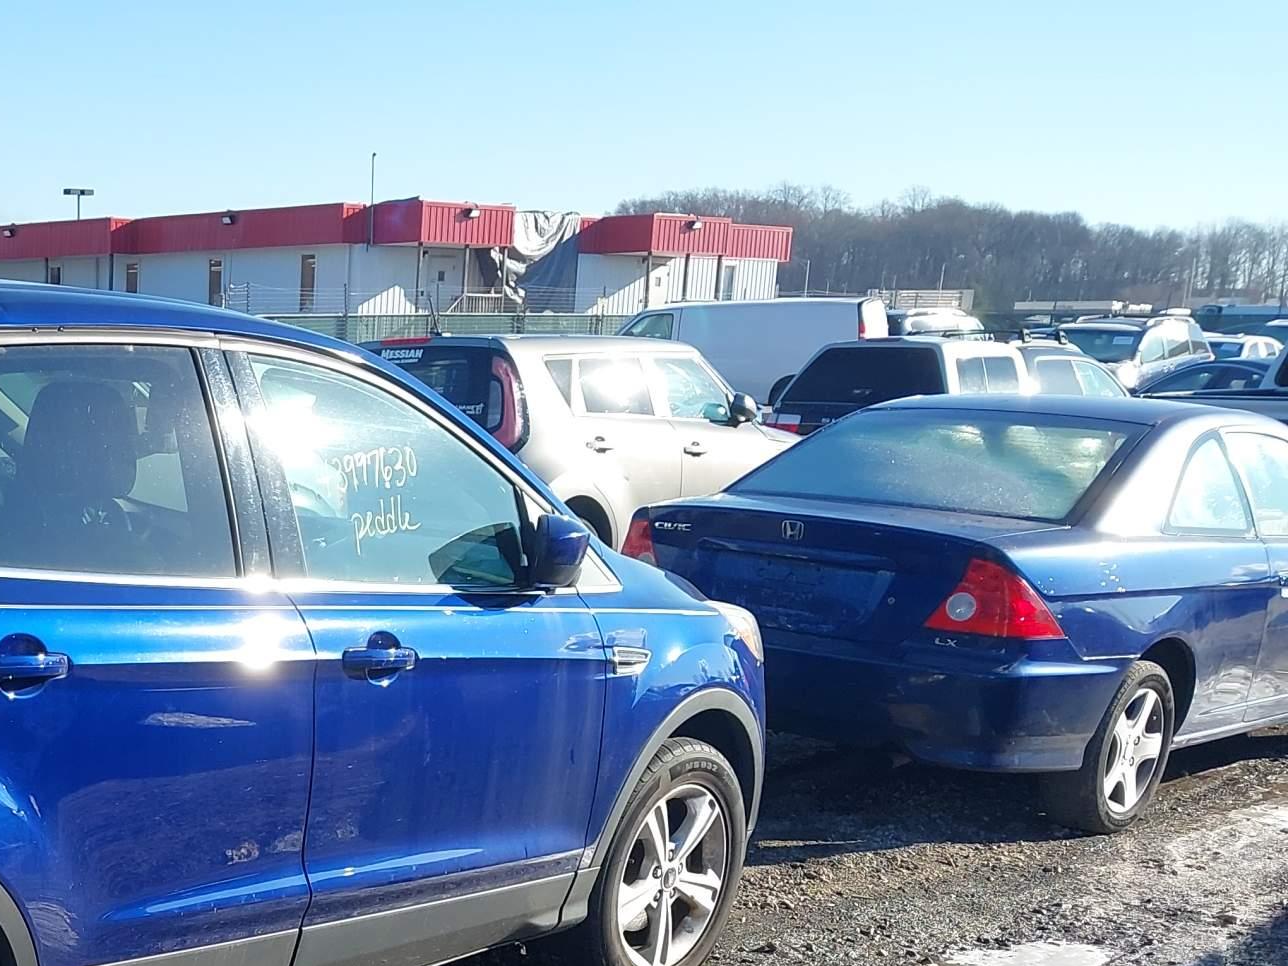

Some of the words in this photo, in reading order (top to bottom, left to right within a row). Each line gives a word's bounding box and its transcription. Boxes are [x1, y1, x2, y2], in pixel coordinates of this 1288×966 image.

[381, 348, 424, 360] MESSIAH
[324, 446, 417, 492] 3997630
[934, 637, 959, 649] LX
